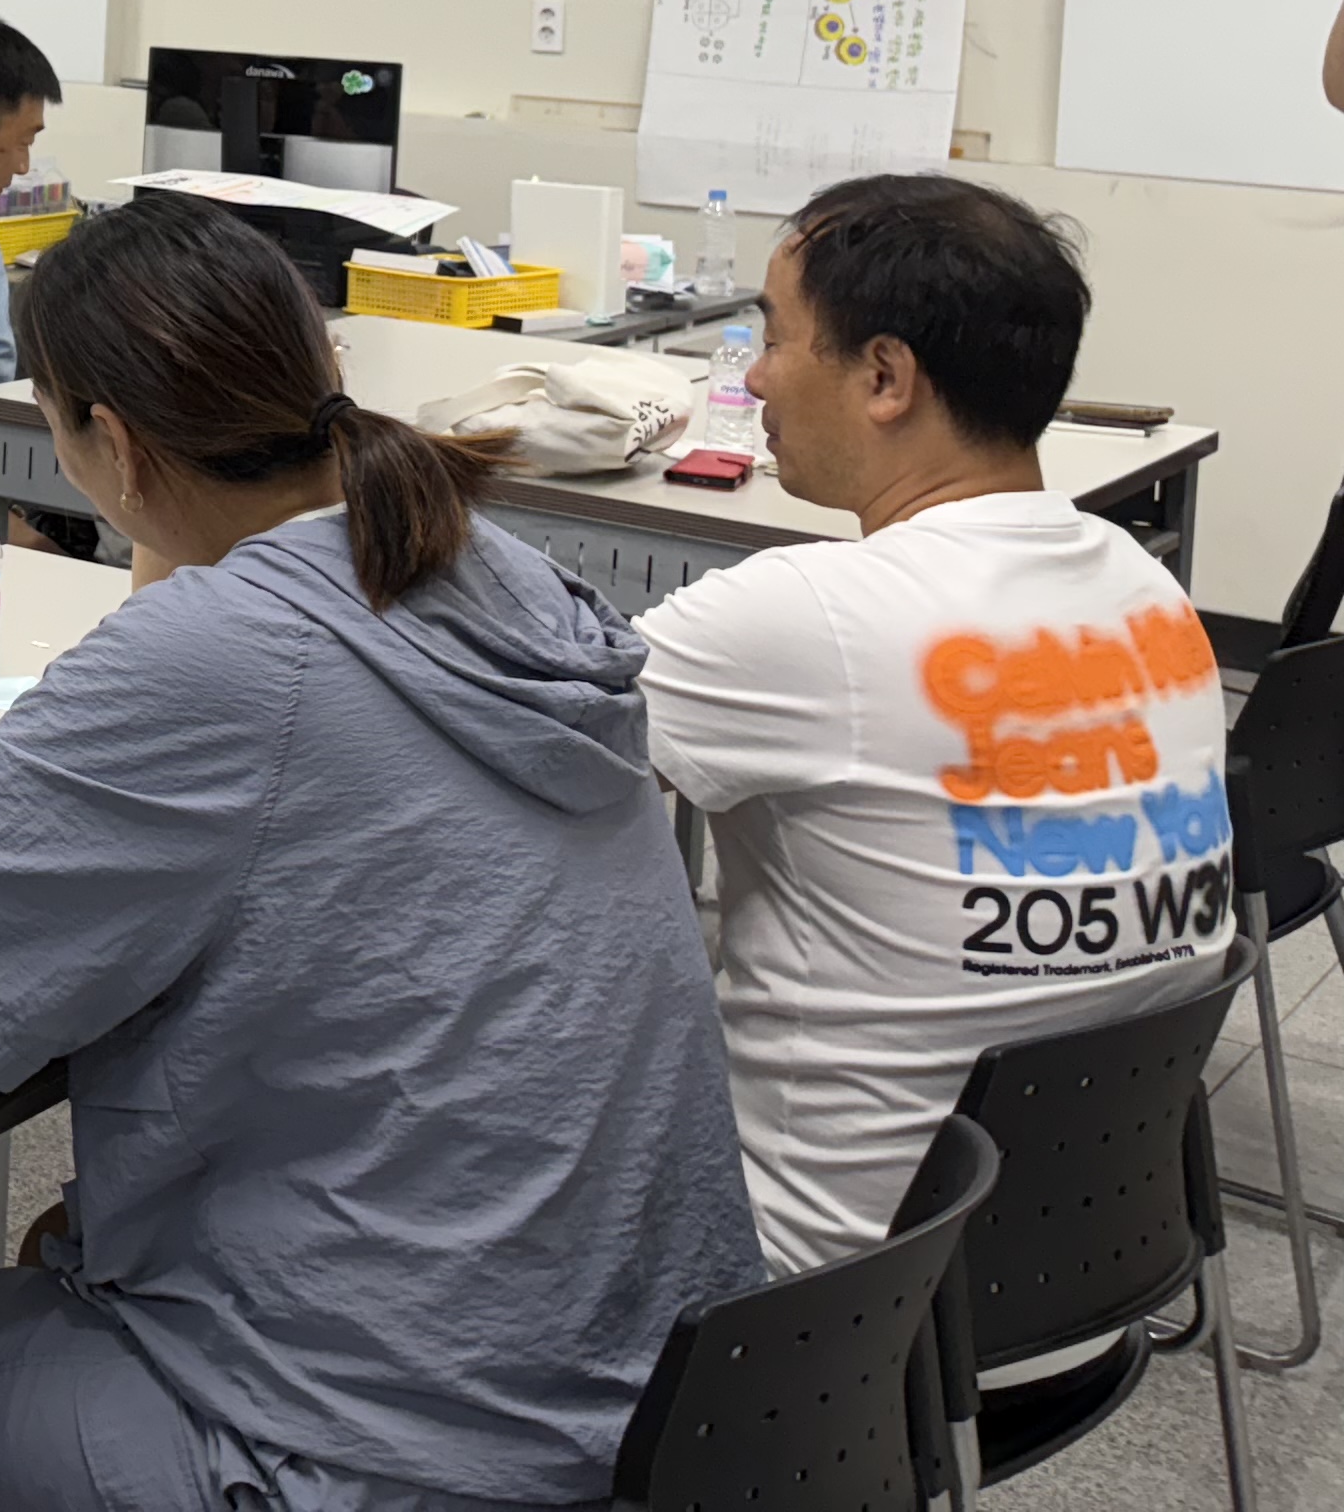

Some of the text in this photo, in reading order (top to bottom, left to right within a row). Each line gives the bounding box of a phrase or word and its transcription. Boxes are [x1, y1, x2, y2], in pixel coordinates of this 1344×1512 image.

[245, 65, 284, 79] danawa
[949, 804, 1138, 877] New
[961, 887, 1118, 955] 205
[962, 959, 1040, 977] Registered
[1115, 949, 1171, 970] Established
